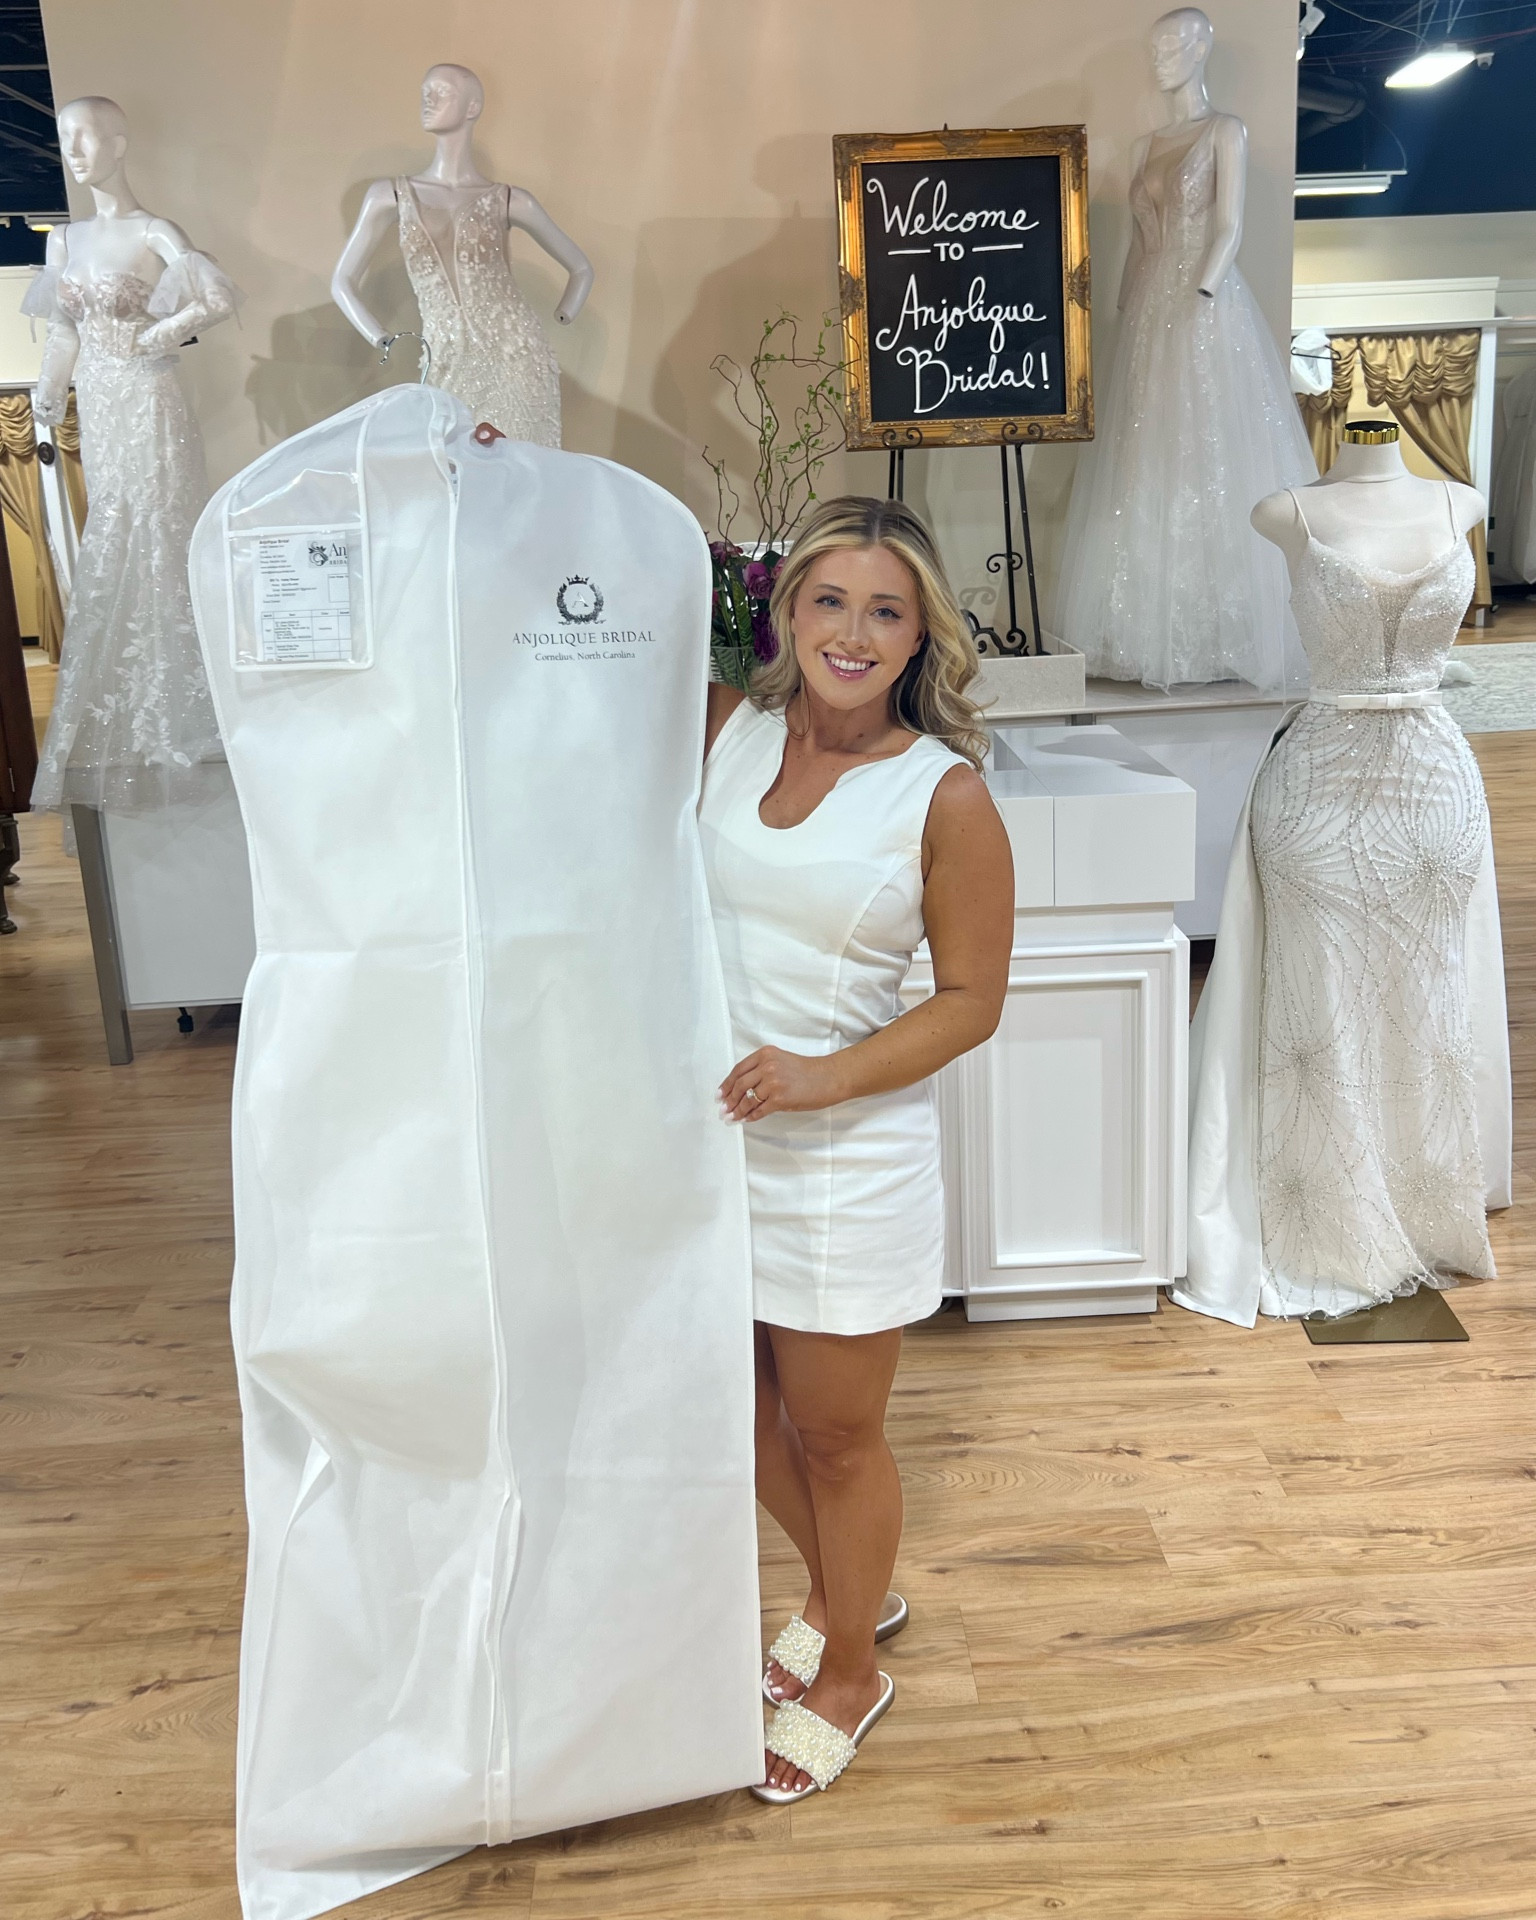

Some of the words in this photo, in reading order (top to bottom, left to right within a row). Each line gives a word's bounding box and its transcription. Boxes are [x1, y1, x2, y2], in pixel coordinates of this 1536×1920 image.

[866, 177, 1040, 237] Welcome
[933, 242, 965, 262] TO
[875, 273, 1047, 353] Anjolique
[896, 346, 1050, 414] Bridal!
[329, 542, 348, 559] An
[512, 632, 597, 648] ANJOLIQUE
[602, 631, 656, 644] BRIDAL
[577, 651, 601, 661] North
[603, 650, 636, 660] Carolina
